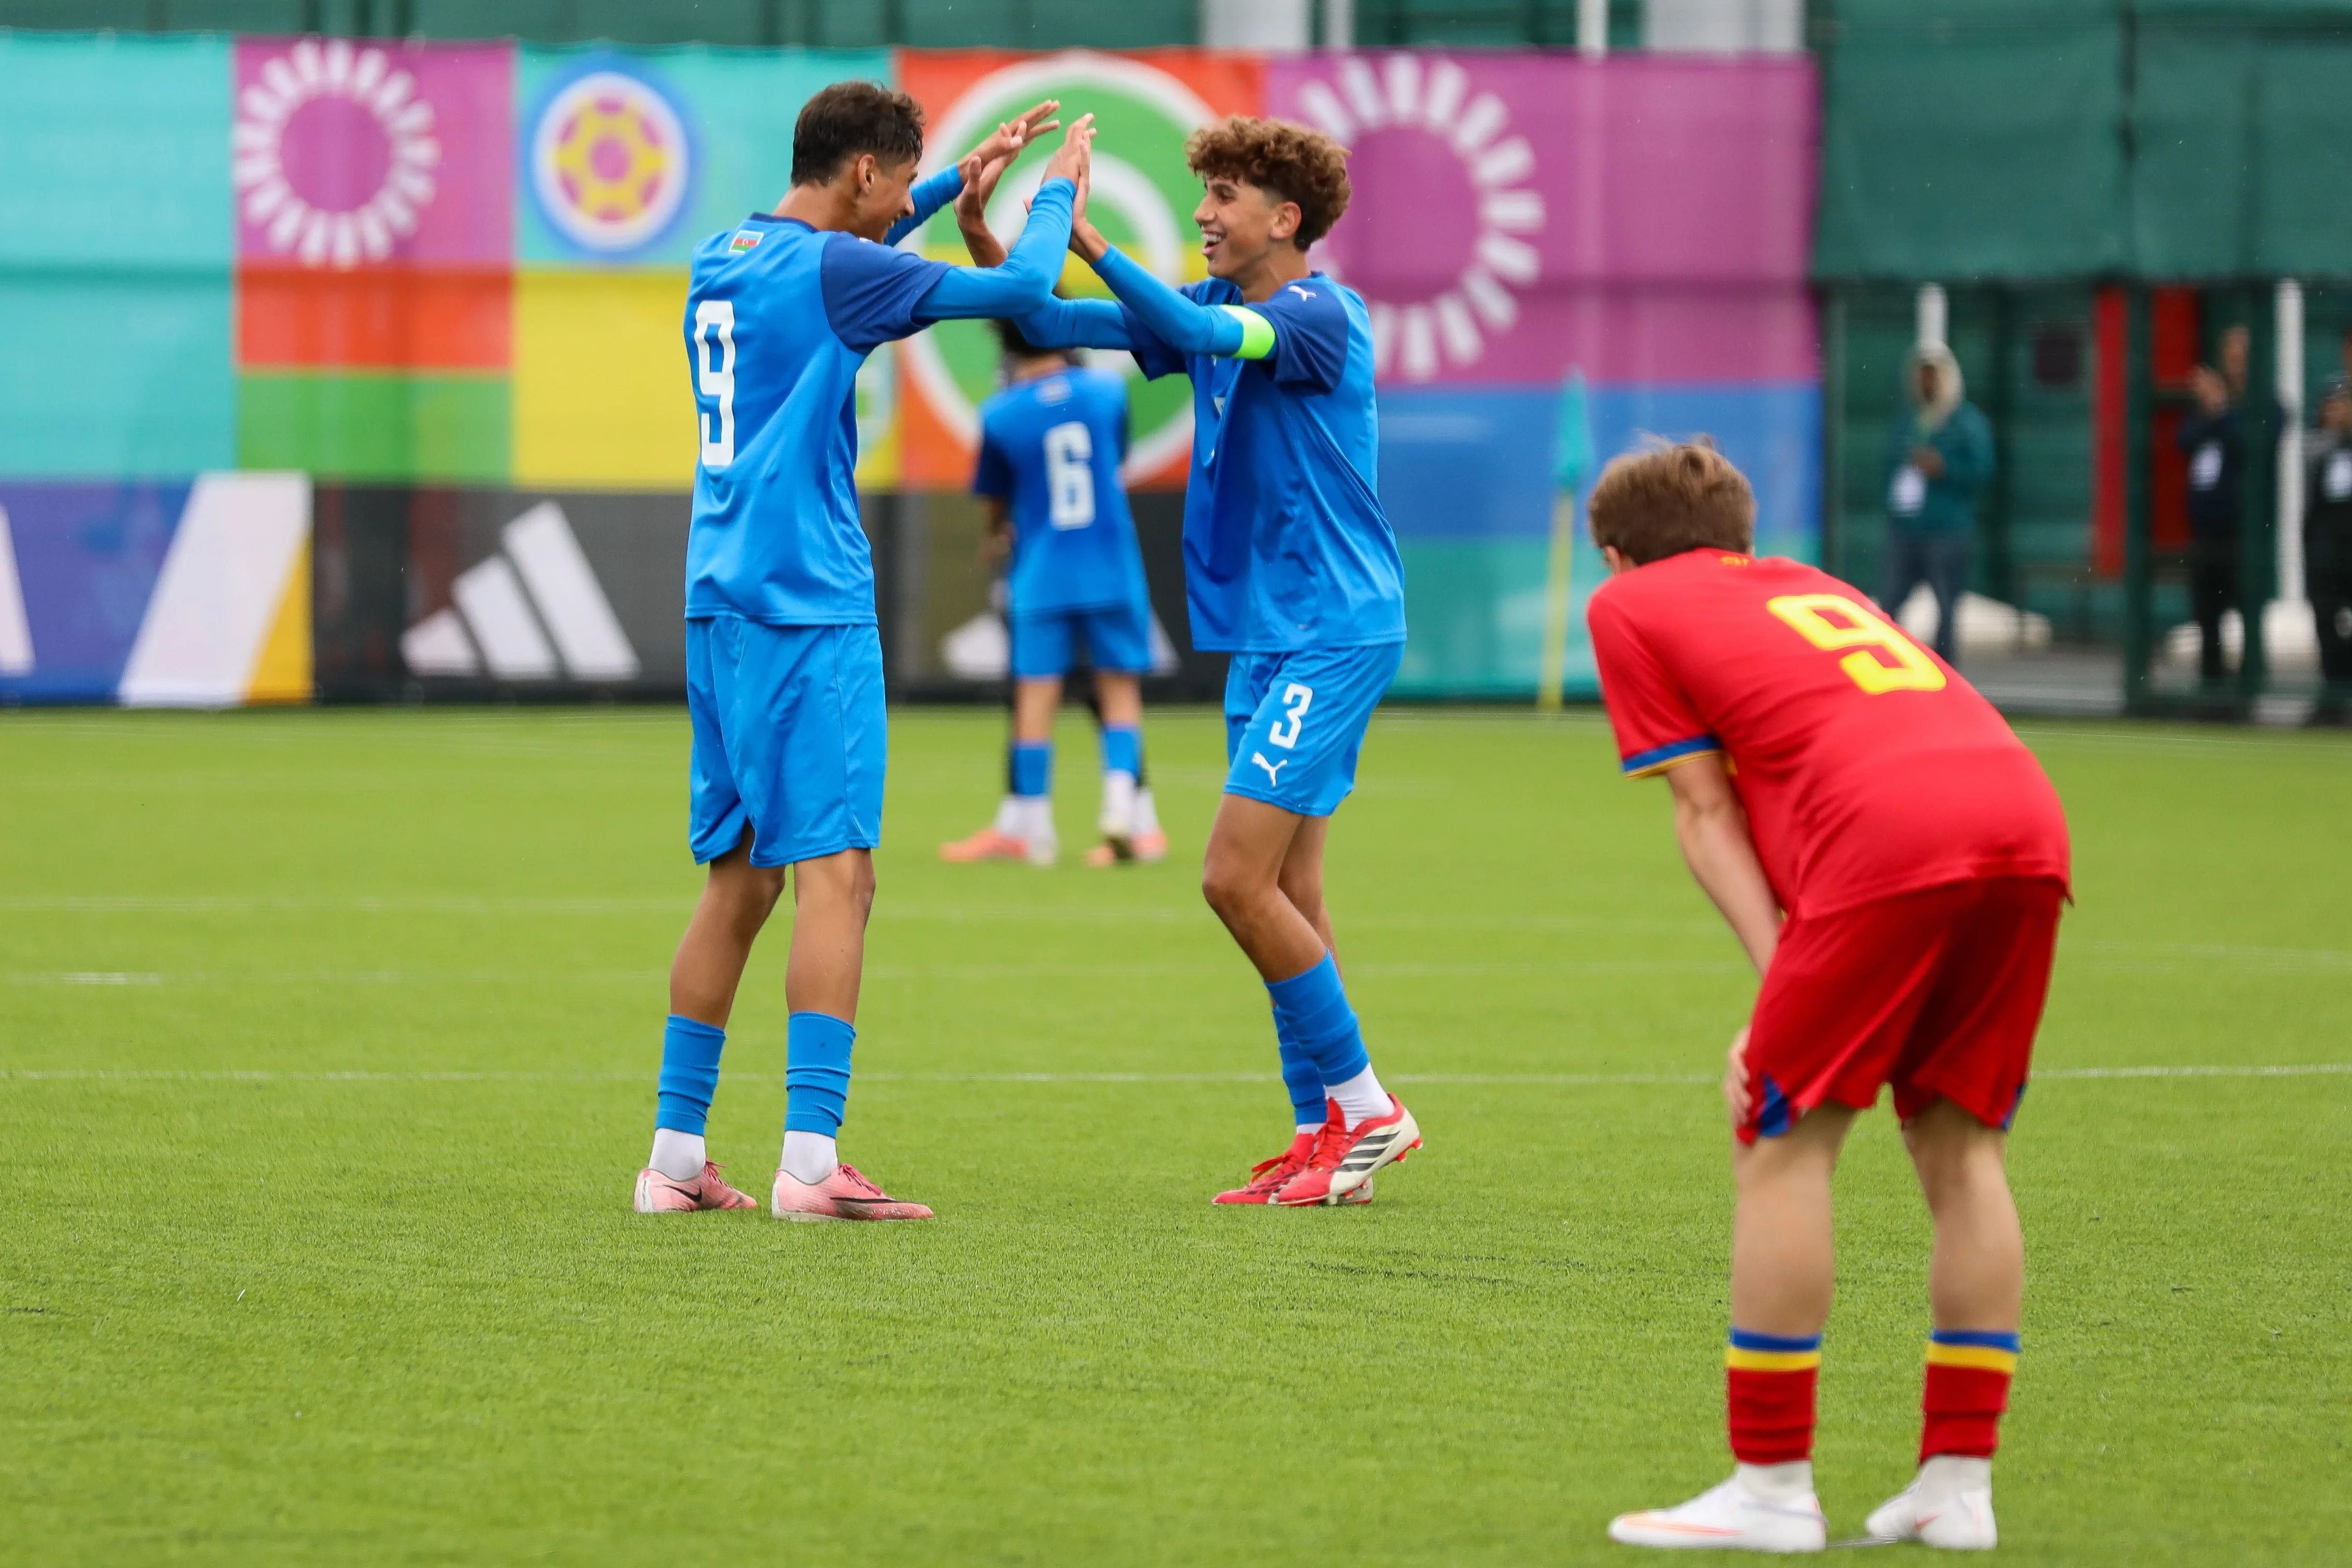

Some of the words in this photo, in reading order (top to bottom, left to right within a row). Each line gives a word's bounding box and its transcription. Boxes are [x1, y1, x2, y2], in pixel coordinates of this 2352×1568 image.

[693, 300, 736, 467] 9
[1044, 421, 1095, 530] 6
[1766, 593, 1947, 695] 9
[1268, 682, 1313, 749] 3
